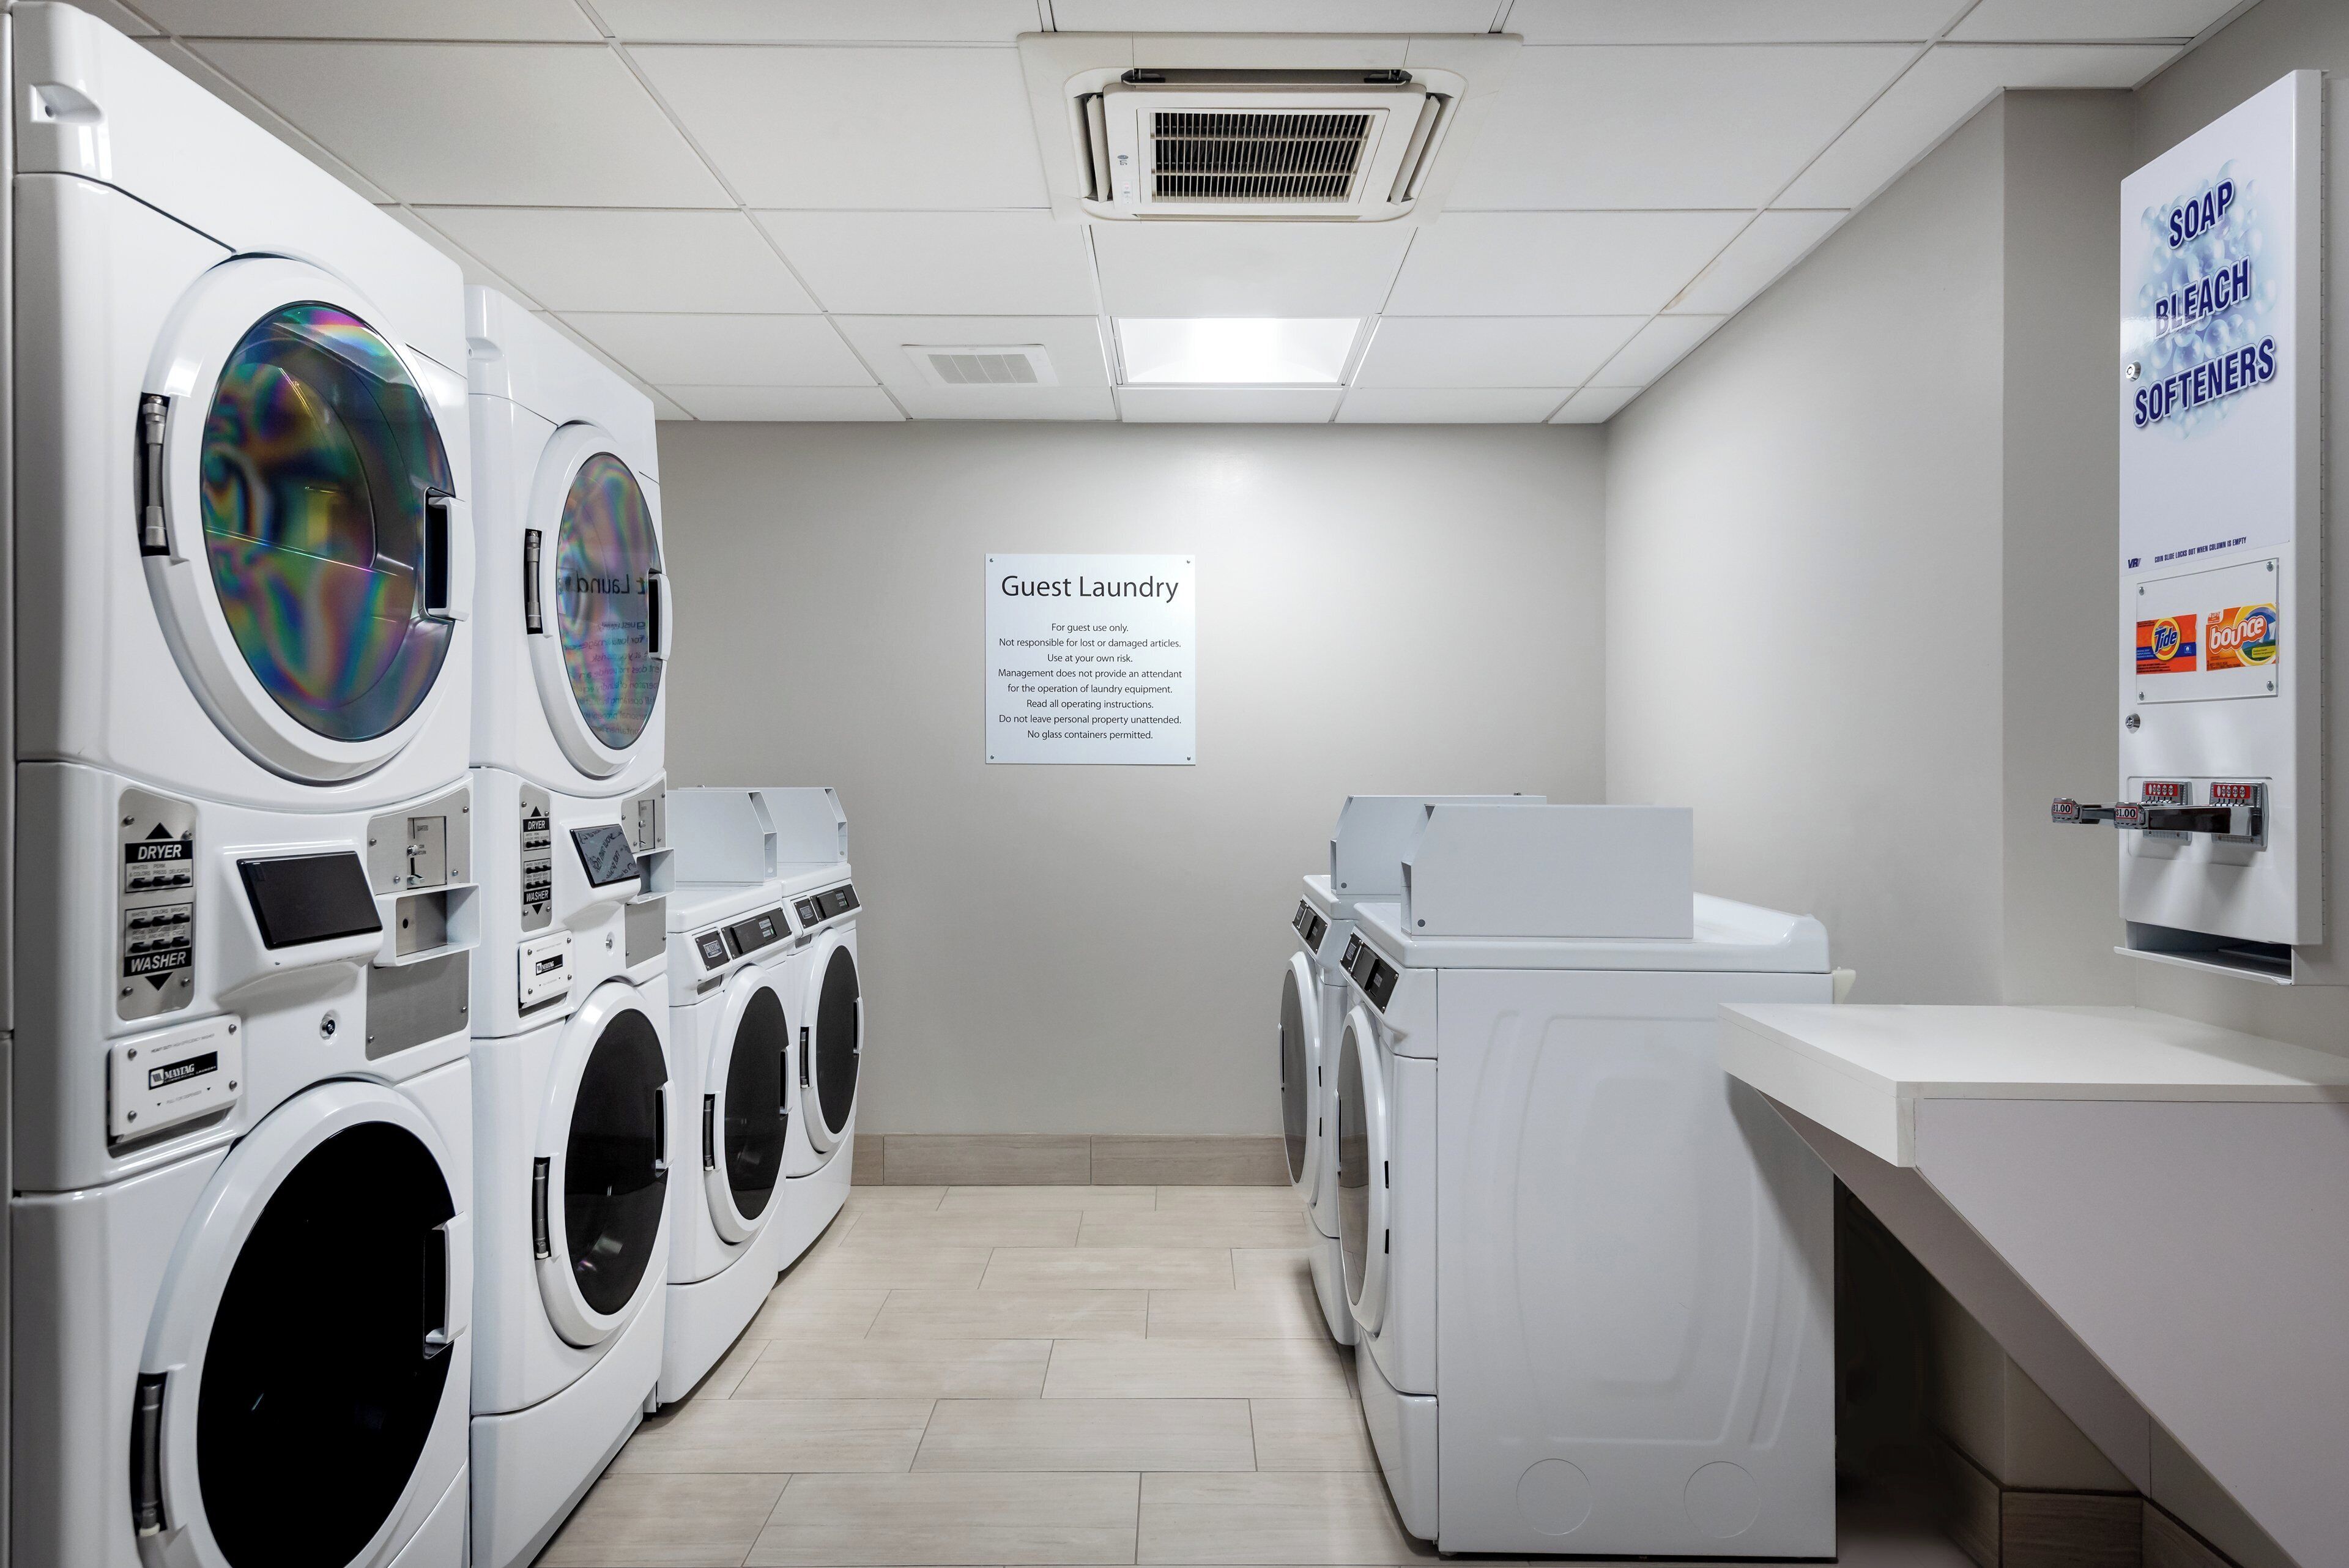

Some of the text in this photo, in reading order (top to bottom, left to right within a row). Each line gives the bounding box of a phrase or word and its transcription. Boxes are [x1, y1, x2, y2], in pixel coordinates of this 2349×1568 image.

[2169, 179, 2234, 249] SOAP
[2154, 257, 2250, 338] BLEACH
[2134, 336, 2276, 427] SOFTENERS
[2164, 552, 2175, 561] SLIDE
[2175, 549, 2188, 559] LOCKS
[2197, 545, 2208, 554] WHEN
[2209, 541, 2226, 552] COLUMN
[2233, 536, 2247, 546] EMPTY
[1001, 575, 1179, 604] Guest Laundry
[1052, 623, 1066, 631] For
[1067, 624, 1091, 634] guest
[1109, 623, 1129, 634] only.
[2210, 616, 2265, 650] bounce
[999, 637, 1015, 647] Not
[1017, 637, 1064, 648] responsible
[1066, 637, 1078, 647] for
[1080, 638, 1096, 647] lost
[1108, 638, 1148, 649] damaged
[1150, 639, 1181, 647] articles.
[2153, 626, 2178, 655] Tide
[1047, 653, 1063, 662] Use
[1075, 655, 1094, 664] your
[1117, 653, 1133, 663] risk.
[998, 668, 1054, 679] Management
[1056, 668, 1077, 677] does
[1095, 669, 1127, 680] provide
[1141, 669, 1182, 678] attendant
[1007, 683, 1173, 695] for the operation of laundry equipment.
[1026, 699, 1154, 710] Read all operating instructions.
[999, 714, 1012, 723] Do
[1030, 714, 1052, 723] leave
[1053, 715, 1089, 725] personal
[1091, 716, 1129, 726] property
[1130, 715, 1182, 724] unattended.
[1027, 729, 1153, 741] No glass containers permitted.
[2053, 804, 2071, 813] $1.00
[2116, 808, 2136, 817] $1.00
[527, 820, 546, 830] DRYER
[138, 844, 182, 860] DRYER
[526, 890, 549, 902] WASHER
[131, 951, 187, 973] WASHER
[164, 1063, 195, 1080] MAYTAG
